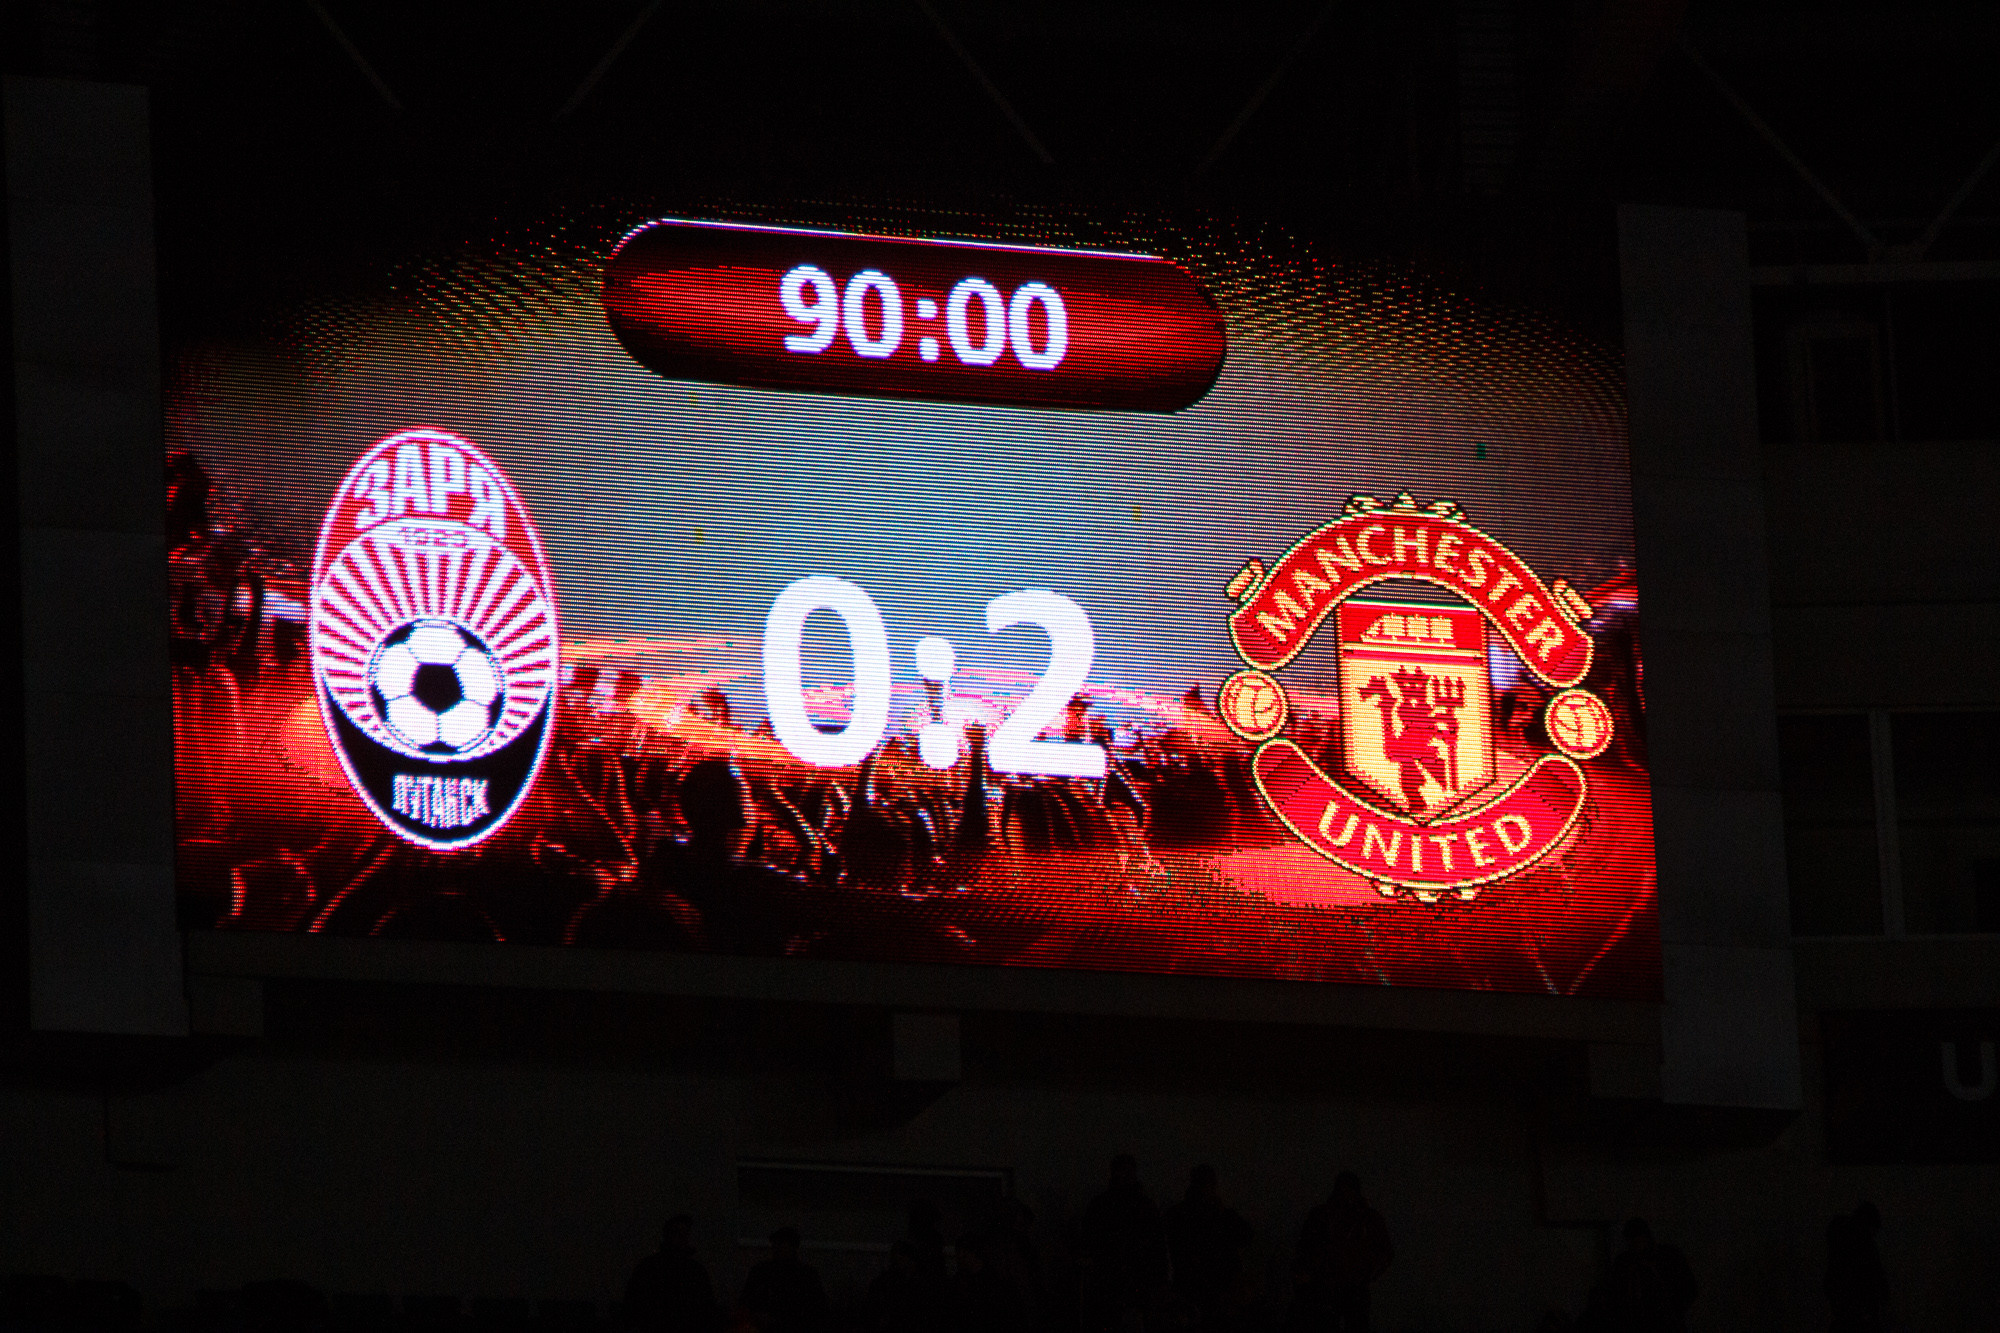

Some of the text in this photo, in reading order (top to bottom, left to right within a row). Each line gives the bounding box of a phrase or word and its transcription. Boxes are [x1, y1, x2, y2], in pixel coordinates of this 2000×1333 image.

[780, 265, 1068, 371] 90:00
[354, 443, 506, 541] ЗАРЯ
[1257, 526, 1566, 662] MANCHESTER
[1318, 800, 1532, 873] UNITED
